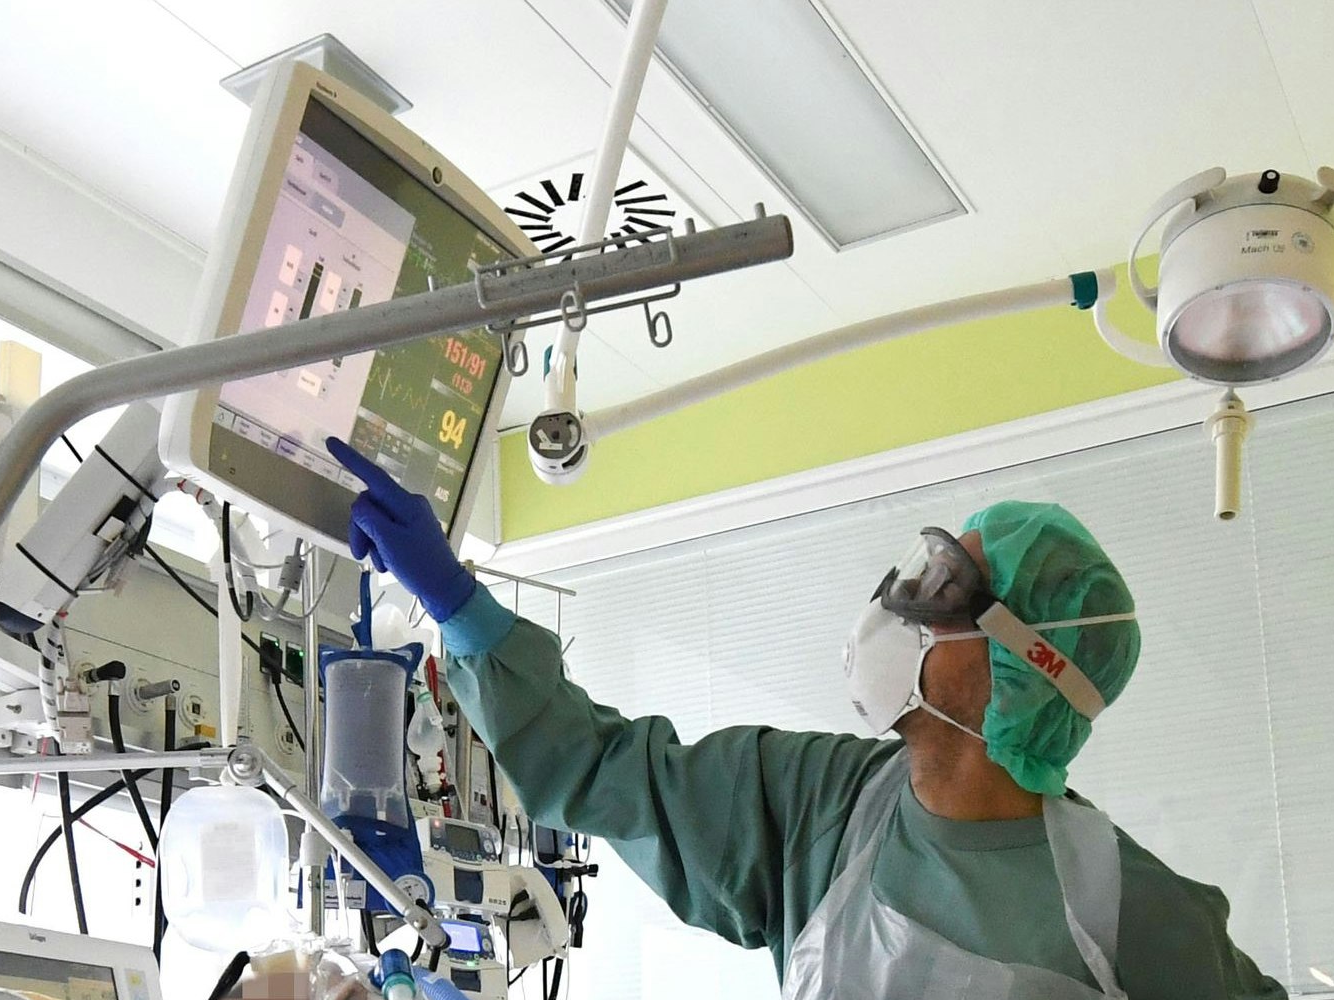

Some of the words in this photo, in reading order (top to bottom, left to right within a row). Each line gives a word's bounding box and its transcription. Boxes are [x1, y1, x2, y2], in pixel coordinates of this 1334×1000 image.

[444, 337, 486, 380] 151/91
[439, 410, 467, 450] 94
[1027, 641, 1066, 679] 3M
